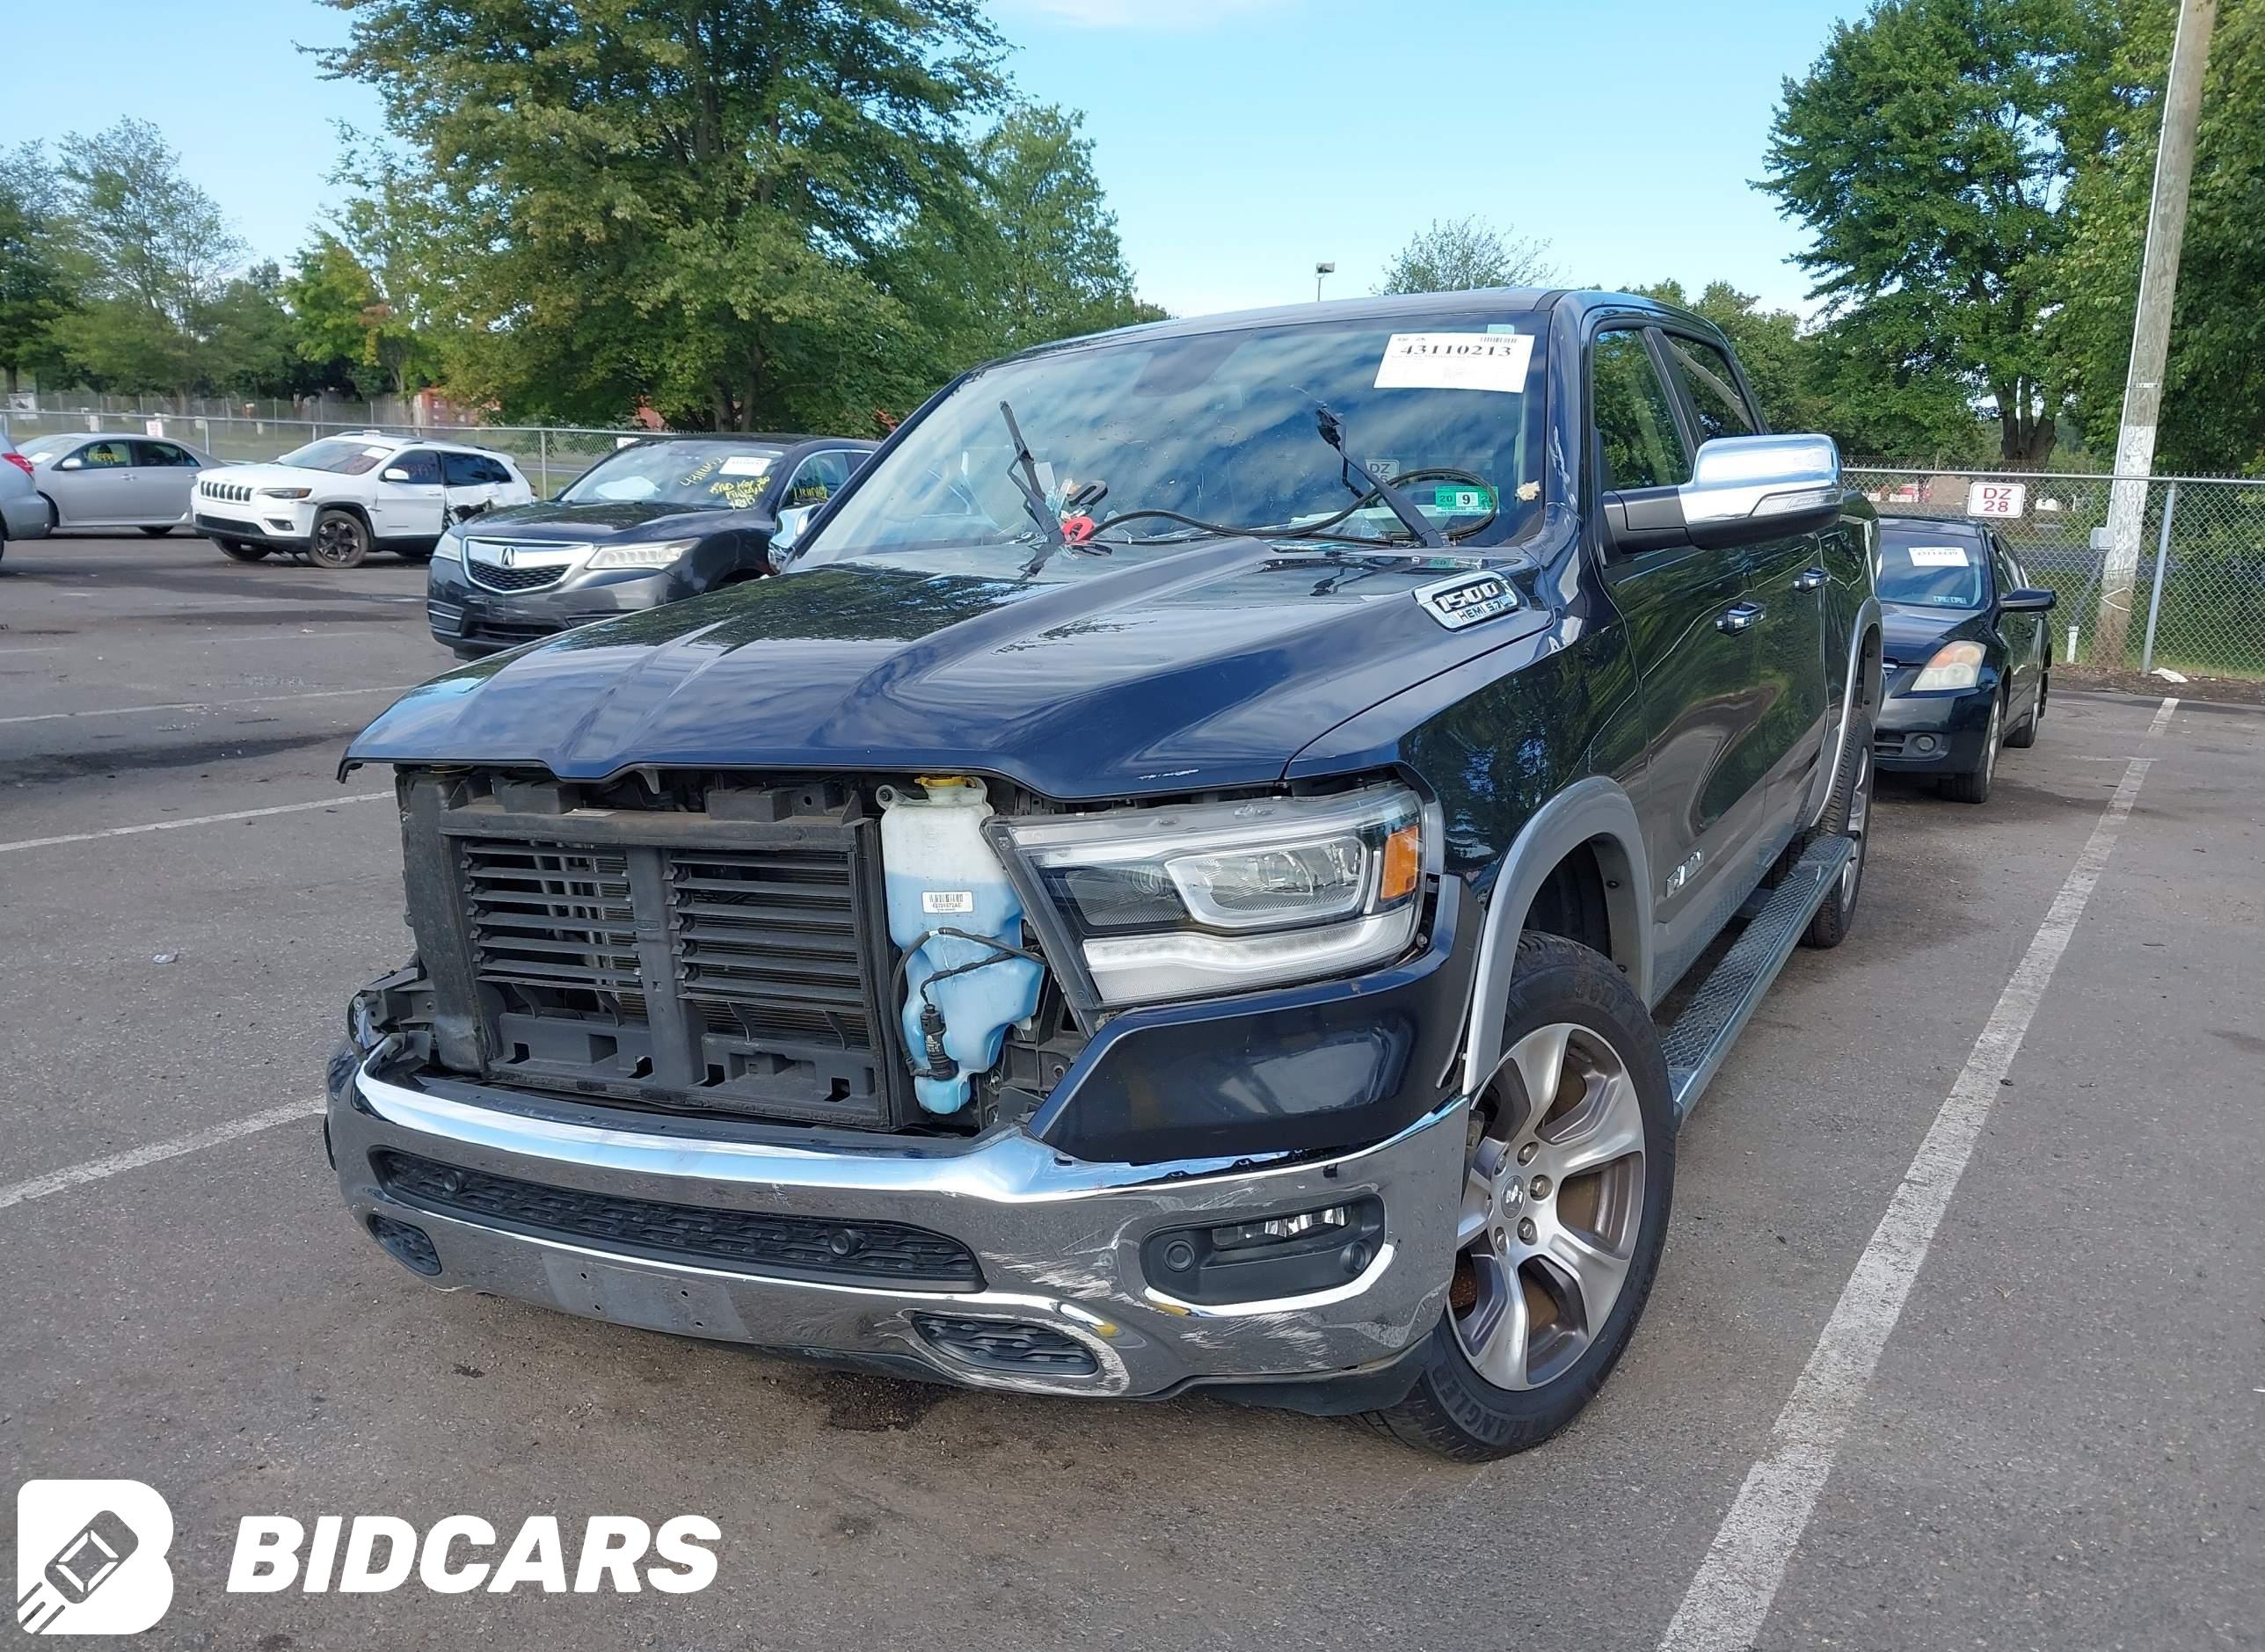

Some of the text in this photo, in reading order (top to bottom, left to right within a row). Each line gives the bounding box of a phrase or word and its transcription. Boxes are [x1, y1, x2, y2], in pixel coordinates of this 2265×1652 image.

[1401, 345, 1511, 356] 43110213
[1370, 463, 1390, 474] DZ
[1983, 487, 2012, 499] DZ
[1461, 494, 1471, 505] 9
[1983, 500, 2008, 512] 28
[1435, 582, 1499, 612] 1500
[1457, 607, 1486, 622] HEMI
